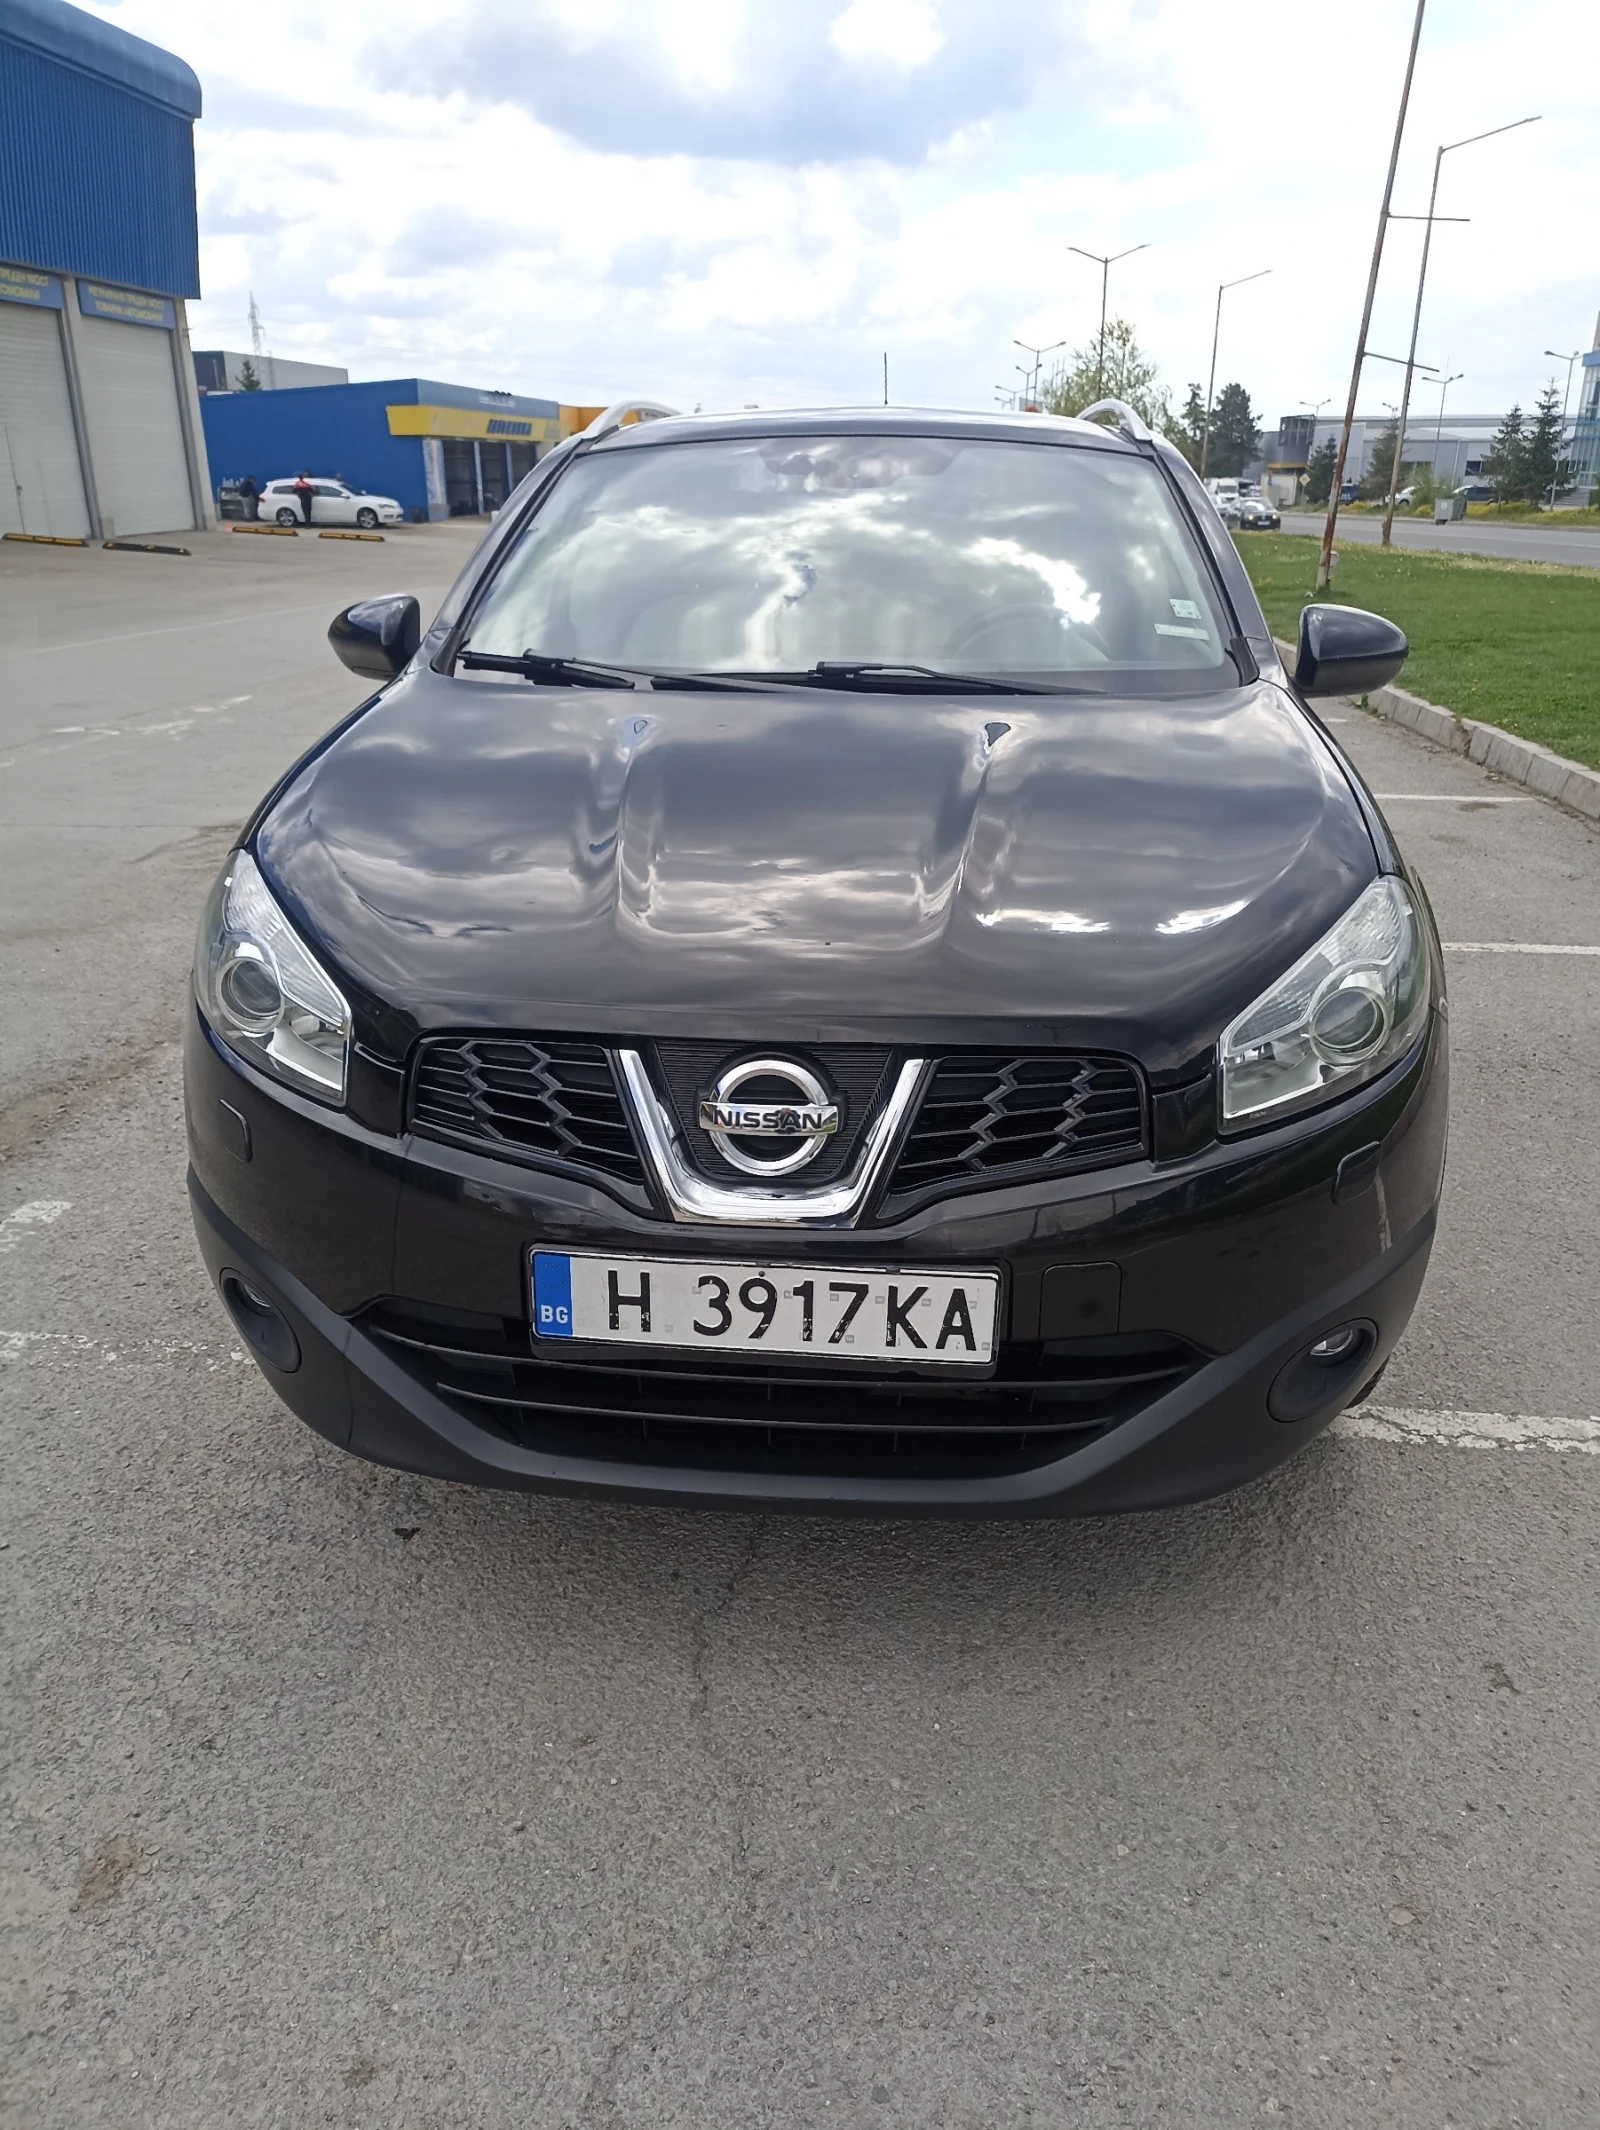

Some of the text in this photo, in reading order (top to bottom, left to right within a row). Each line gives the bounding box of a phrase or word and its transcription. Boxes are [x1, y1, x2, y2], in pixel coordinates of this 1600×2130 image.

[714, 1108, 823, 1130] NISSAN
[608, 1270, 650, 1332] H
[541, 1305, 568, 1323] BG
